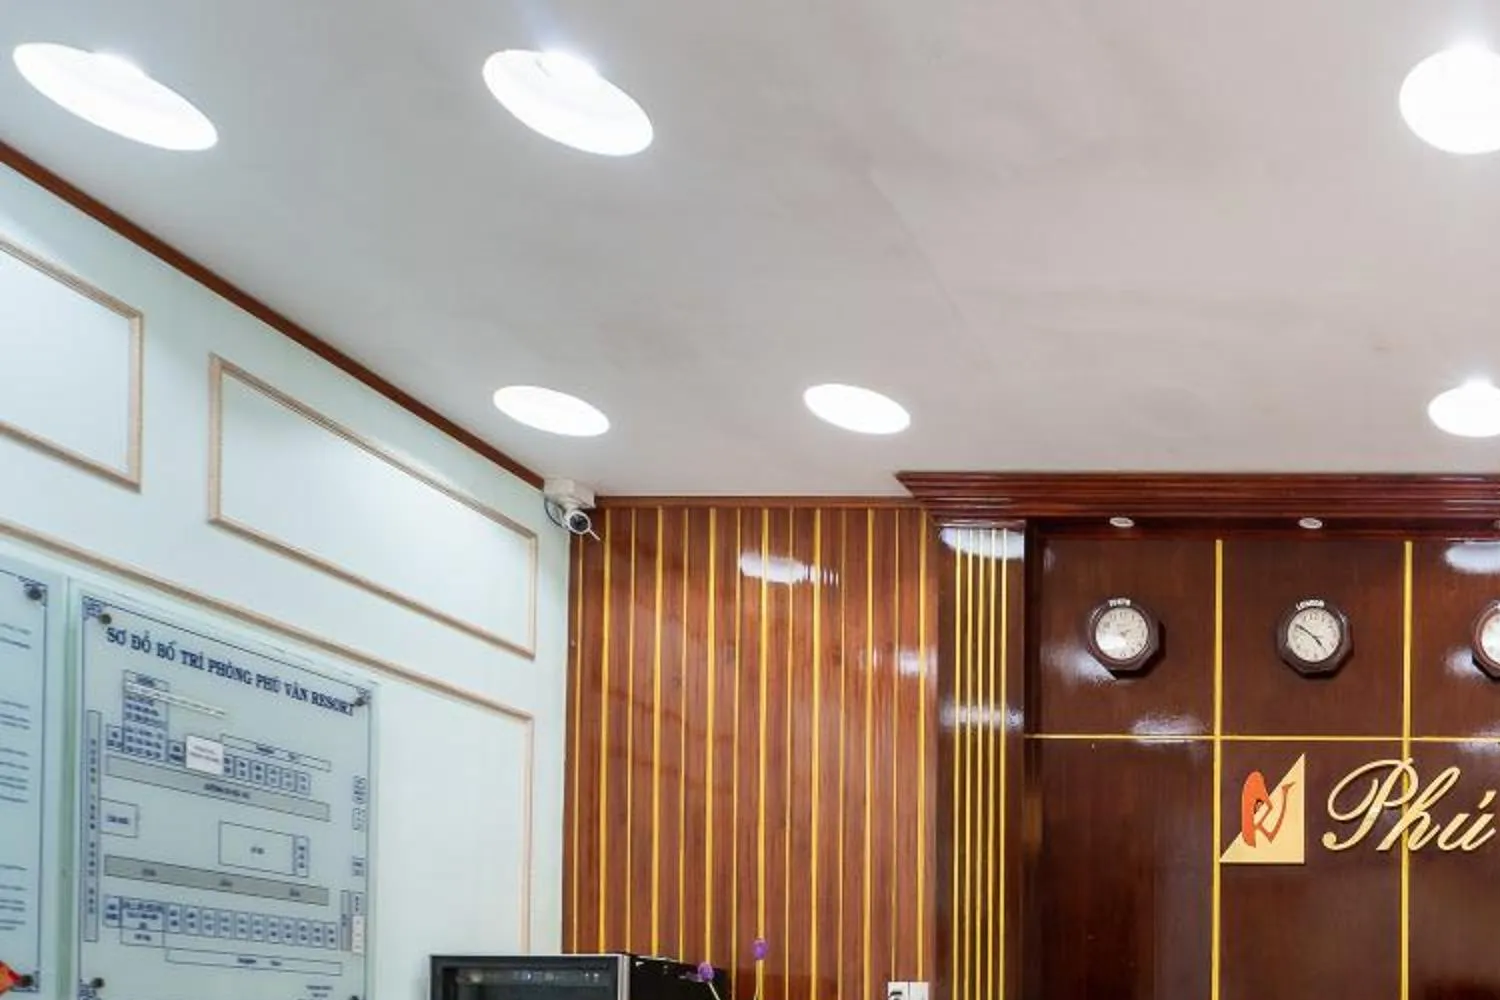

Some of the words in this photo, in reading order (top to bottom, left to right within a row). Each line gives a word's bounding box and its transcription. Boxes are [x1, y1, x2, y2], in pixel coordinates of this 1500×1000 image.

[107, 626, 126, 646] SƠ
[312, 692, 354, 716] RESORT
[1322, 758, 1497, 853] Phú
